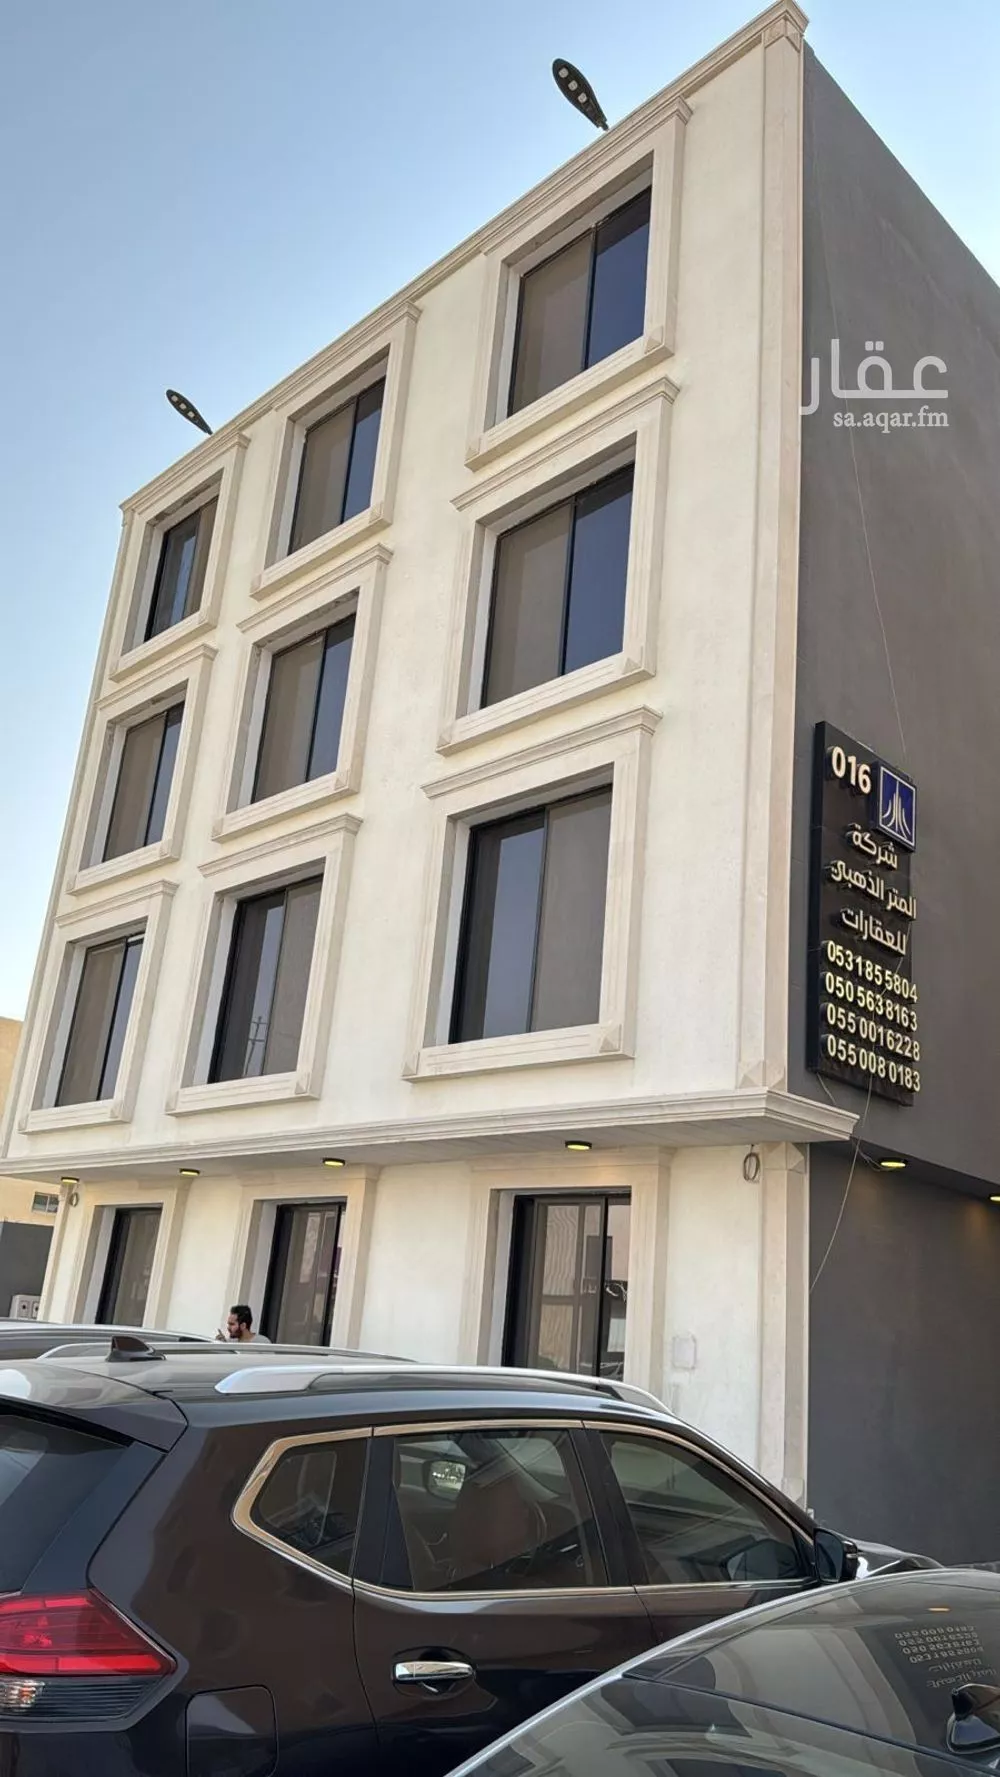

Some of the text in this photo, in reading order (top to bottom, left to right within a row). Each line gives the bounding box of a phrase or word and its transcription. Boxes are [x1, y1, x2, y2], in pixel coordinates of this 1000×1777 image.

[831, 746, 871, 794] 016
[851, 823, 898, 869] شركة
[830, 860, 917, 919] المتر الذهبي
[841, 909, 907, 955] للعقارات
